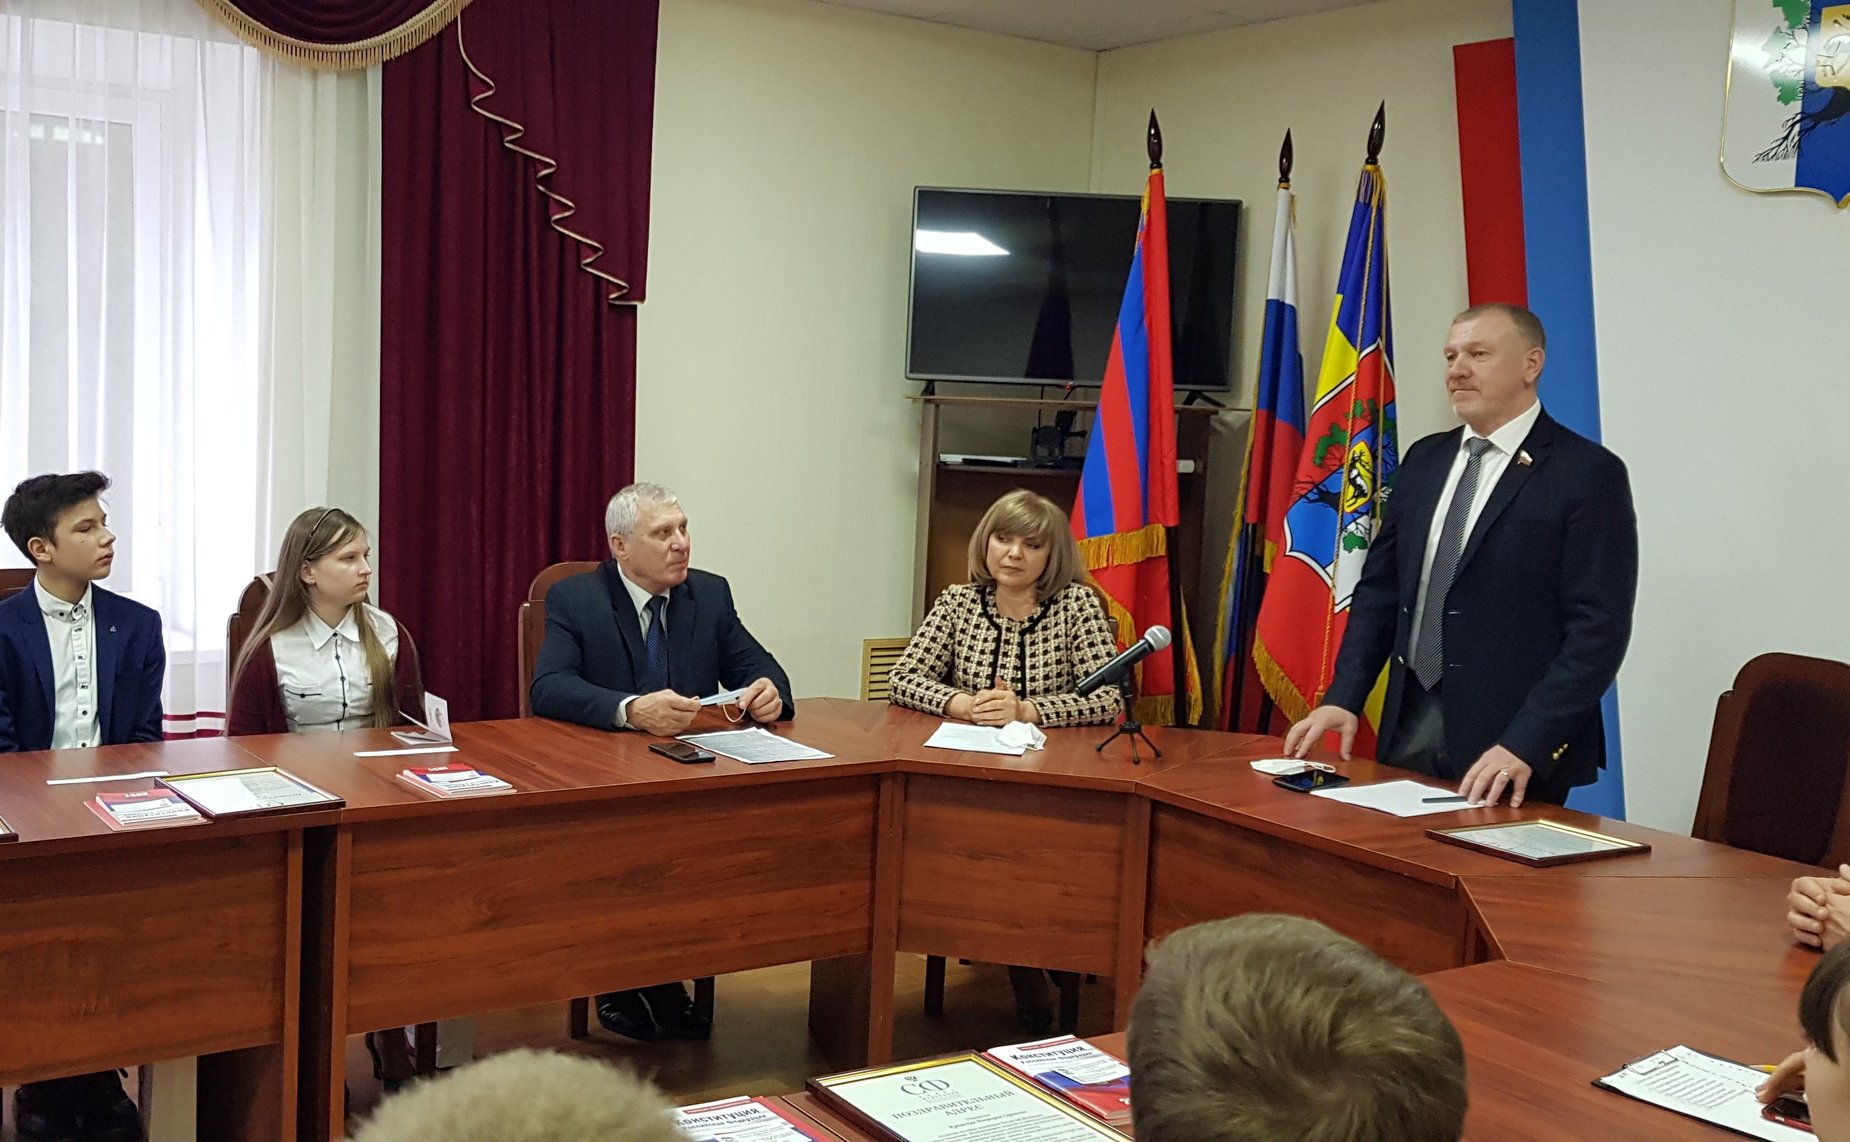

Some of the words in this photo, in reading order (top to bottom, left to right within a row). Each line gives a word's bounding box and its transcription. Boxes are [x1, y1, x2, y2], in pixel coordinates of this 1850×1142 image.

[900, 1079, 950, 1096] СФ
[892, 1090, 1015, 1120] ПОЗДРАВИТЕЛЬНЫЙ
[945, 1104, 985, 1117] АДРЕС
